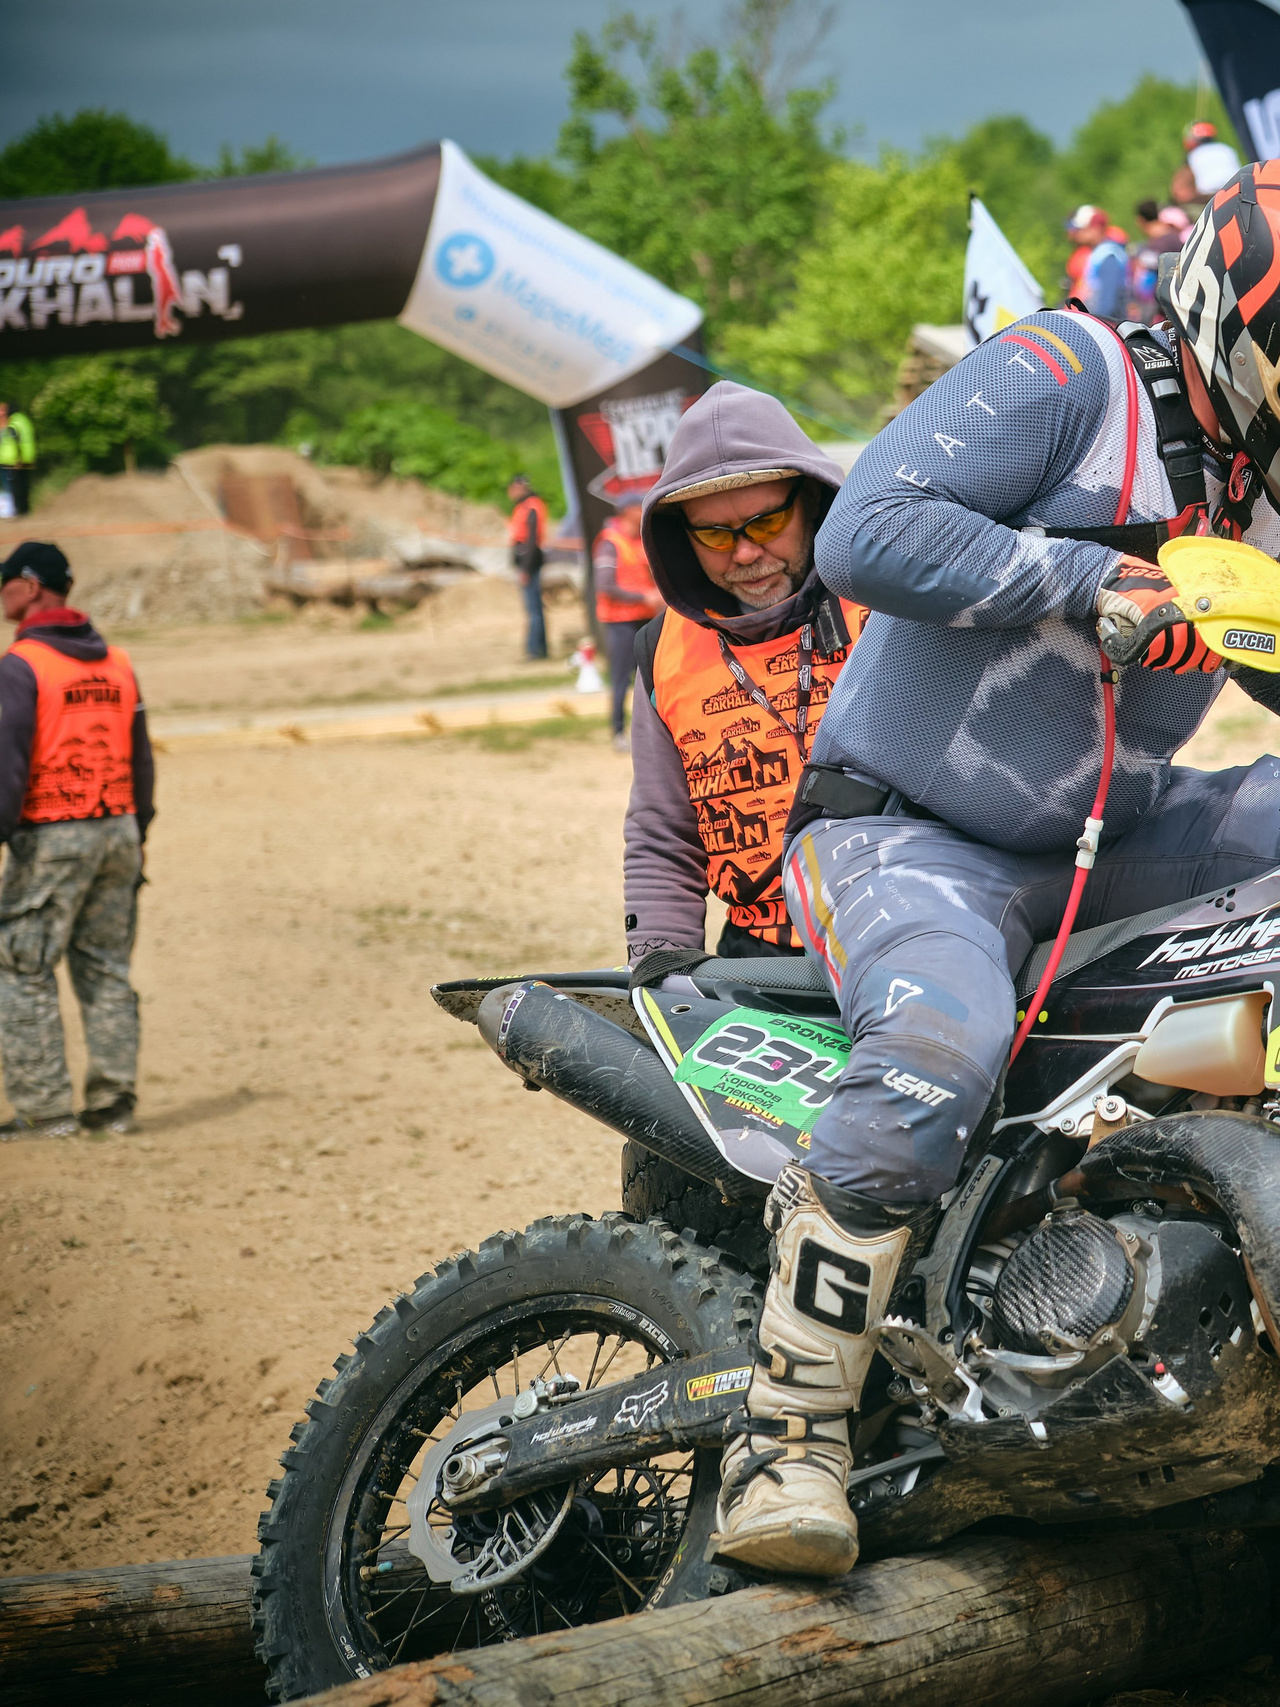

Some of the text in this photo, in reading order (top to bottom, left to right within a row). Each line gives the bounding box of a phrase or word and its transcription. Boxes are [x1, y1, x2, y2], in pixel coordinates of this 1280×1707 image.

[894, 350, 1036, 490] EATT
[1224, 629, 1276, 655] CYCRA
[767, 1018, 853, 1054] BRONZE
[693, 1022, 844, 1108] 234
[714, 1081, 775, 1111] Алексей
[719, 1071, 783, 1104] Коробов
[881, 1066, 957, 1107] LEATT
[638, 1317, 671, 1351] EXCEL
[689, 1370, 751, 1400] PROTAPER
